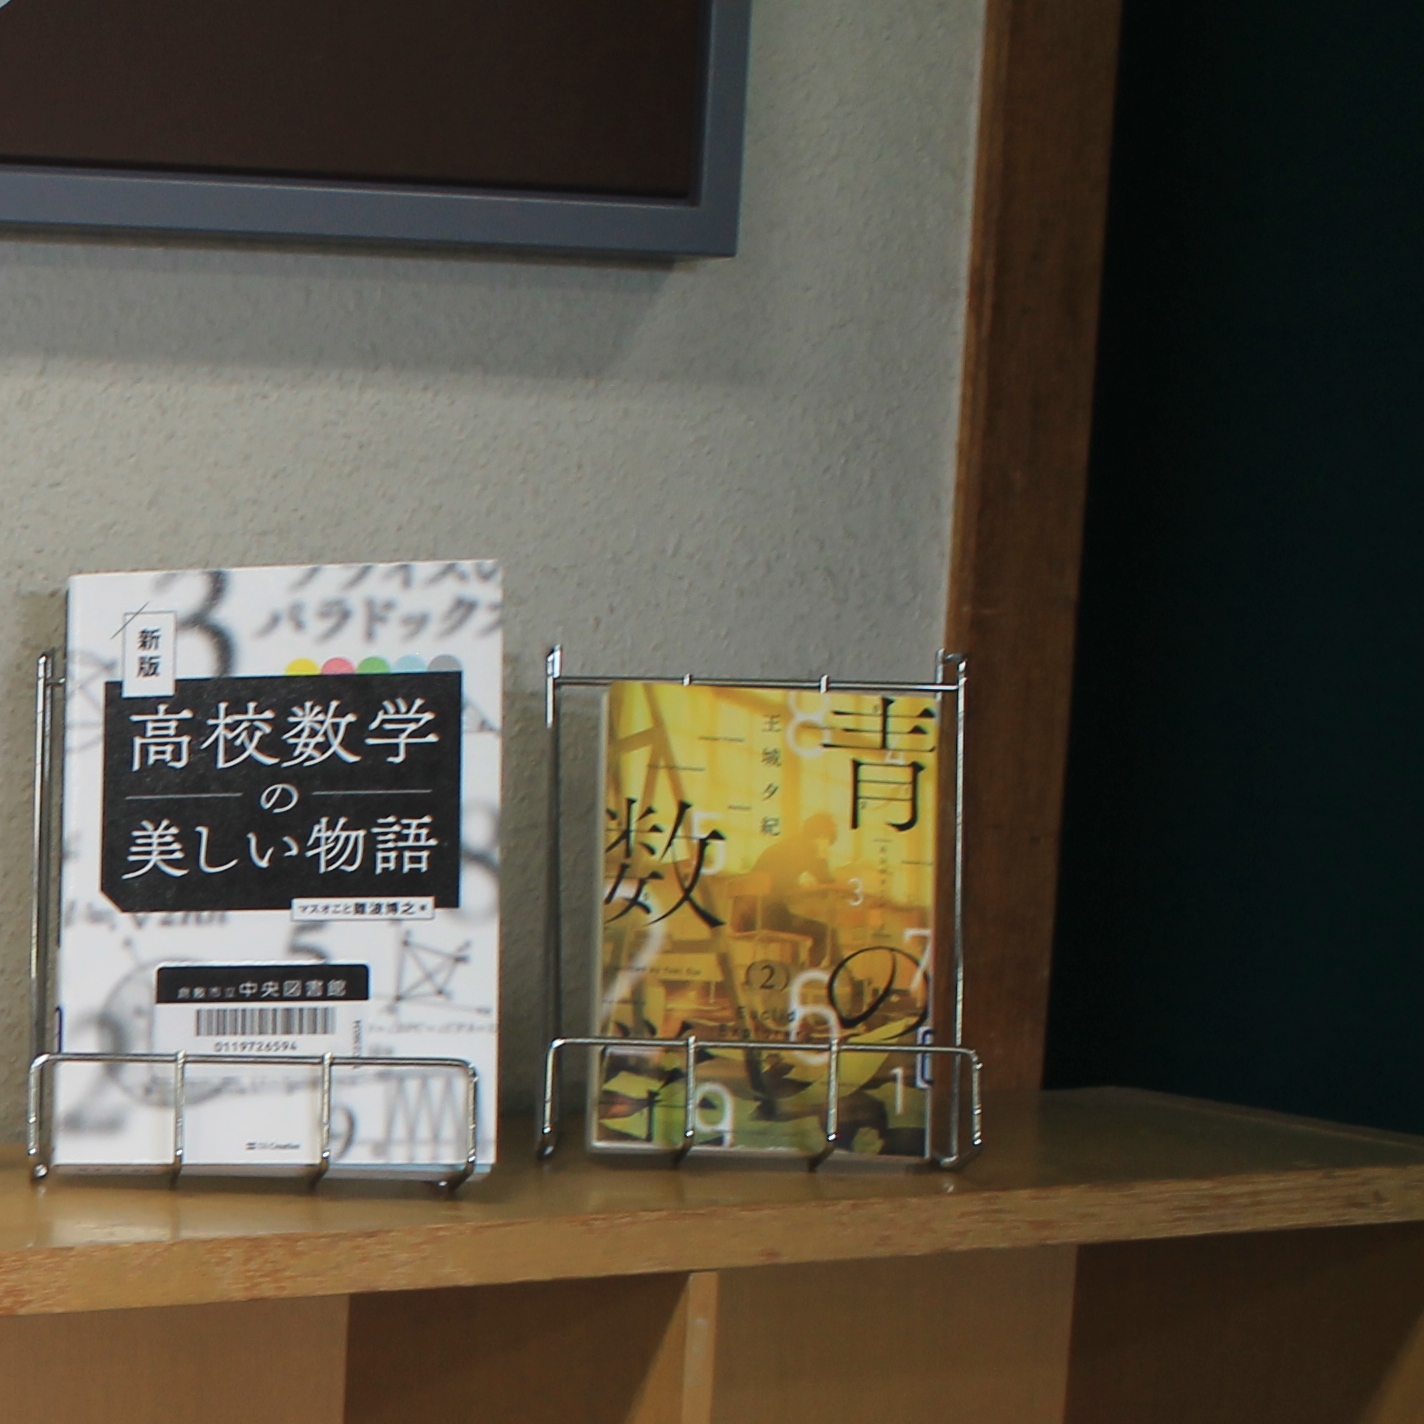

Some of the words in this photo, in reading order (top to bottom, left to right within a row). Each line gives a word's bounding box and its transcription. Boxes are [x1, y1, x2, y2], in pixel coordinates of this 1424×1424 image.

[137, 627, 162, 679] 新版
[128, 697, 441, 773] 高校数学
[761, 714, 782, 838] 王城夕紀
[821, 697, 937, 832] 青
[259, 782, 301, 815] の
[120, 814, 440, 881] 美しい物語
[605, 797, 726, 928] 数
[828, 946, 930, 1038] の
